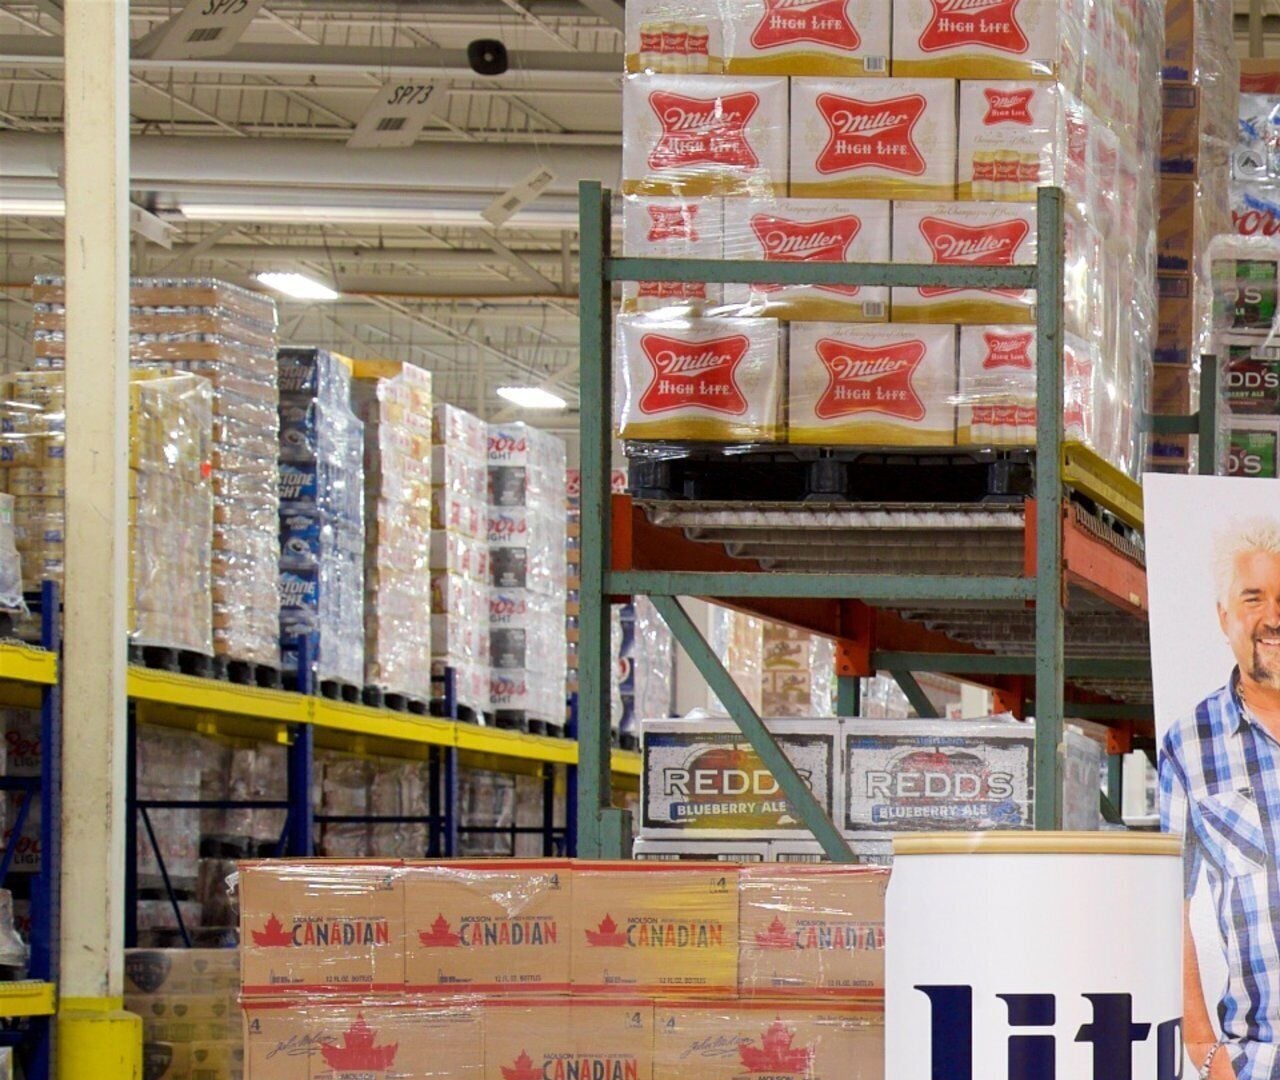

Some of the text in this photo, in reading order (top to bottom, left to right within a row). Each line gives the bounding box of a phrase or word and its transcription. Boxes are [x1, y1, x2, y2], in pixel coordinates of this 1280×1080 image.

[388, 85, 434, 104] SP73
[832, 110, 908, 140] Miller
[656, 350, 732, 377] Miller
[831, 355, 908, 382] Miller
[677, 800, 787, 817] BLUEBERRY ALE
[878, 805, 957, 820] BLUEBERRY
[292, 922, 389, 946] CANADIAN
[460, 922, 557, 947] CANADIAN
[627, 924, 723, 948] CANADIAN
